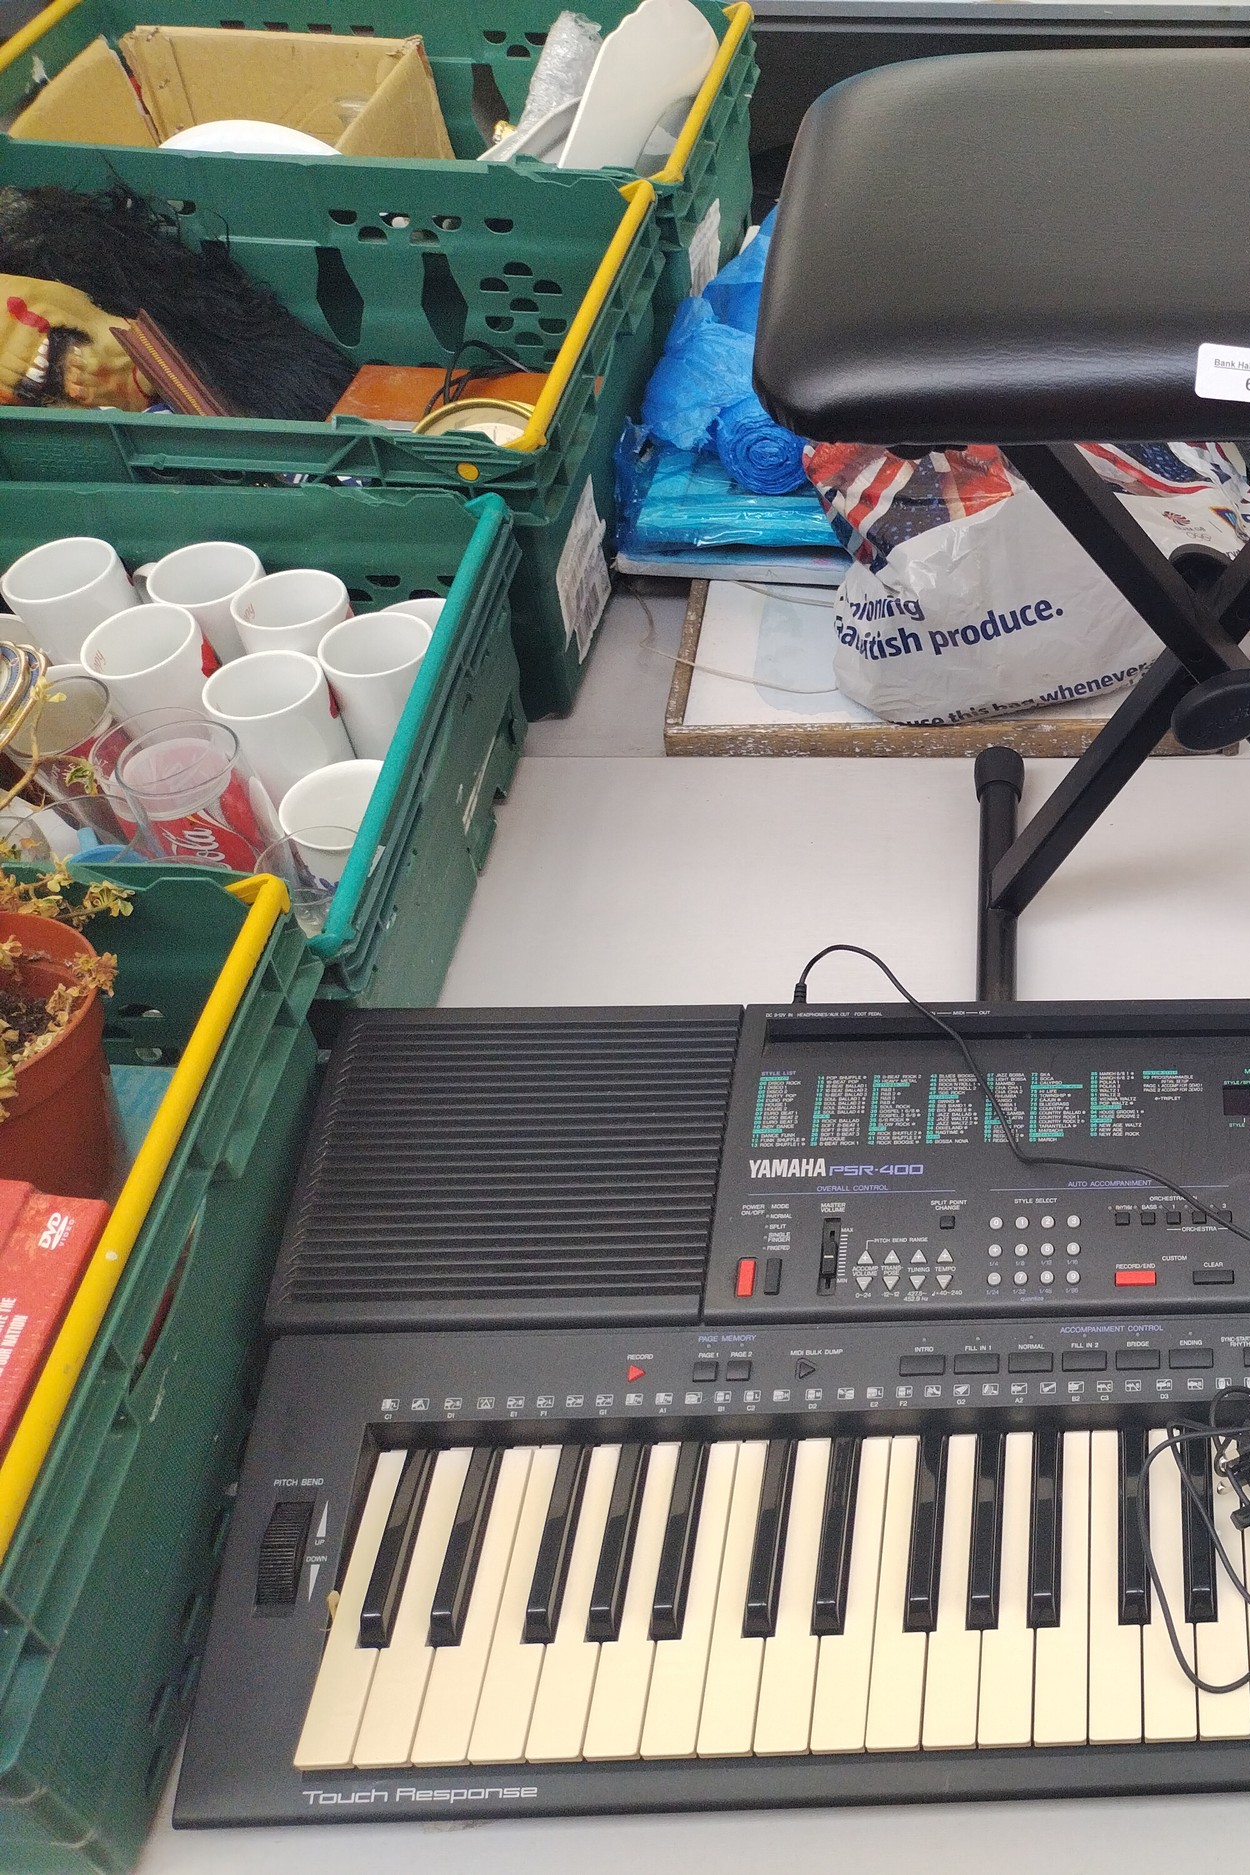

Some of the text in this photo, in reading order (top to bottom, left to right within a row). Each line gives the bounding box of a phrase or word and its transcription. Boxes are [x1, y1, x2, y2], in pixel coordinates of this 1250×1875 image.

[1214, 359, 1235, 368] Bank
[929, 598, 1064, 655] produce.
[949, 704, 989, 723] this
[1039, 661, 1148, 703] whenever
[749, 1158, 924, 1178] YAMAHA PSR-400
[38, 1212, 62, 1251] DVD
[58, 1218, 75, 1247] VIDEO
[1, 1315, 28, 1347] NATION
[698, 1334, 757, 1343] PAGE MEMORY
[1060, 1324, 1164, 1334] ACCOMPANIMENT CONTROL
[273, 1477, 324, 1487] PITCH BEND
[306, 1555, 328, 1563] DOWN
[302, 1785, 538, 1806] Touch Response
